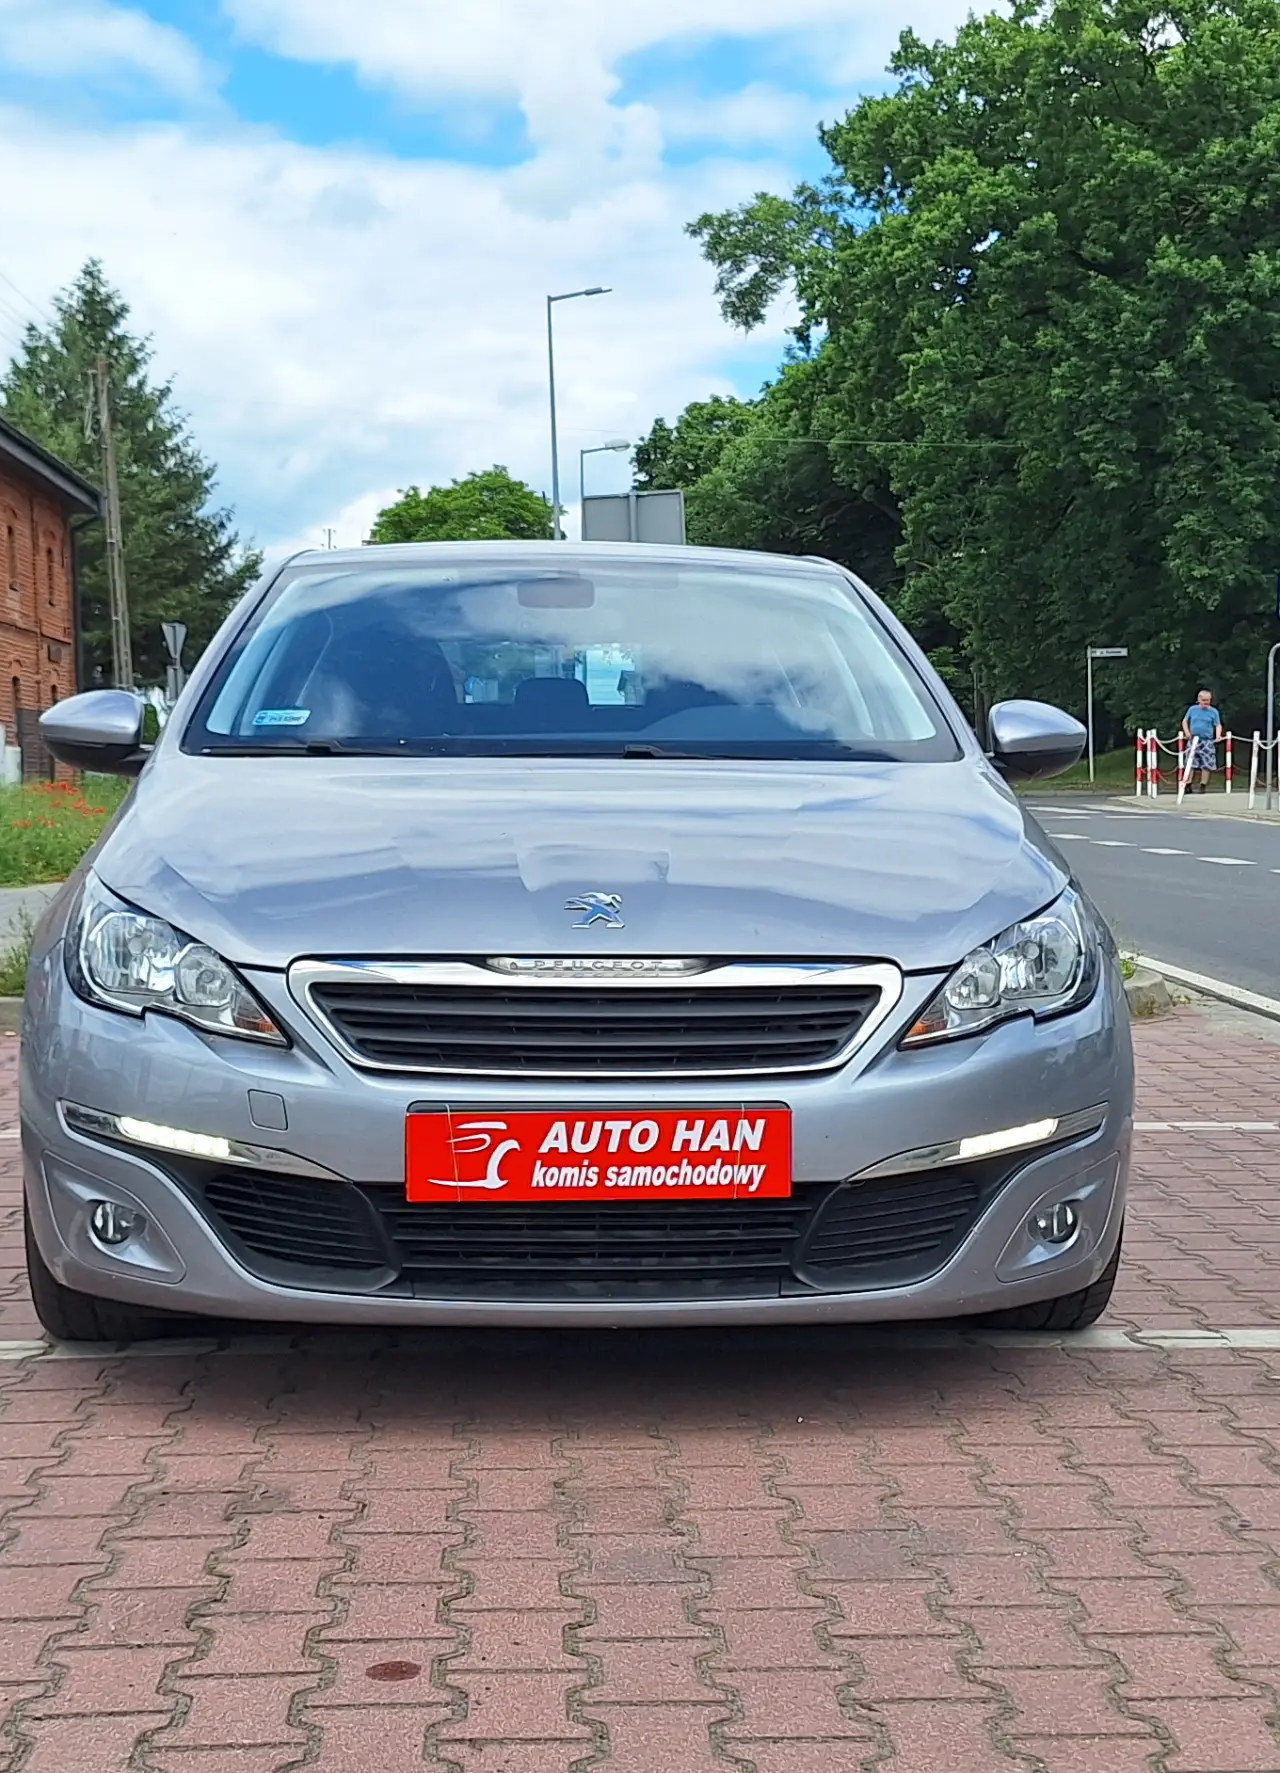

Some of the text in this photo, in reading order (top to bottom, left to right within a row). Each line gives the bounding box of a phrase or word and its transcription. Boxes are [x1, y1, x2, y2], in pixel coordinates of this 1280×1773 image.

[534, 960, 664, 970] PEUGEOT
[537, 1119, 766, 1154] AUTO HAN
[531, 1159, 767, 1193] komis samochodowy
